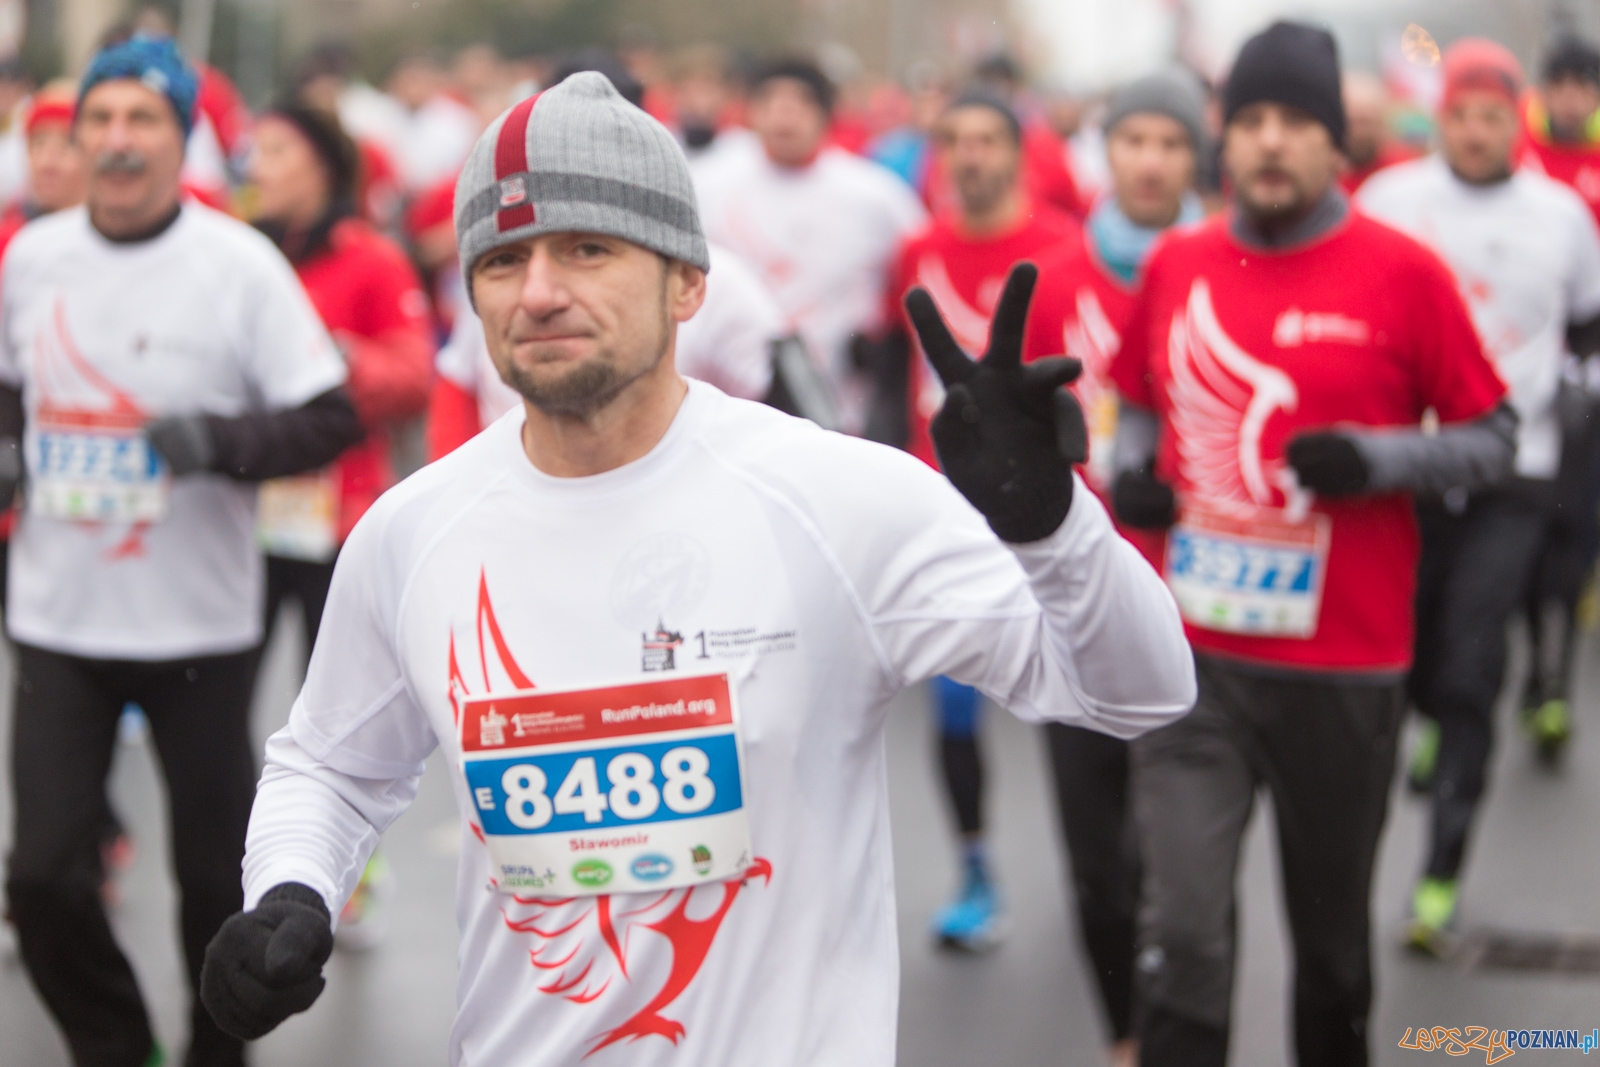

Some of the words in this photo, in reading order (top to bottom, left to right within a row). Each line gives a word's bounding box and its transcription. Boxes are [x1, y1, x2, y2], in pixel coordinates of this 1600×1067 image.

[694, 629, 710, 660] 1
[601, 698, 716, 724] RunPoland.org
[475, 787, 496, 811] E
[501, 745, 717, 830] 8488
